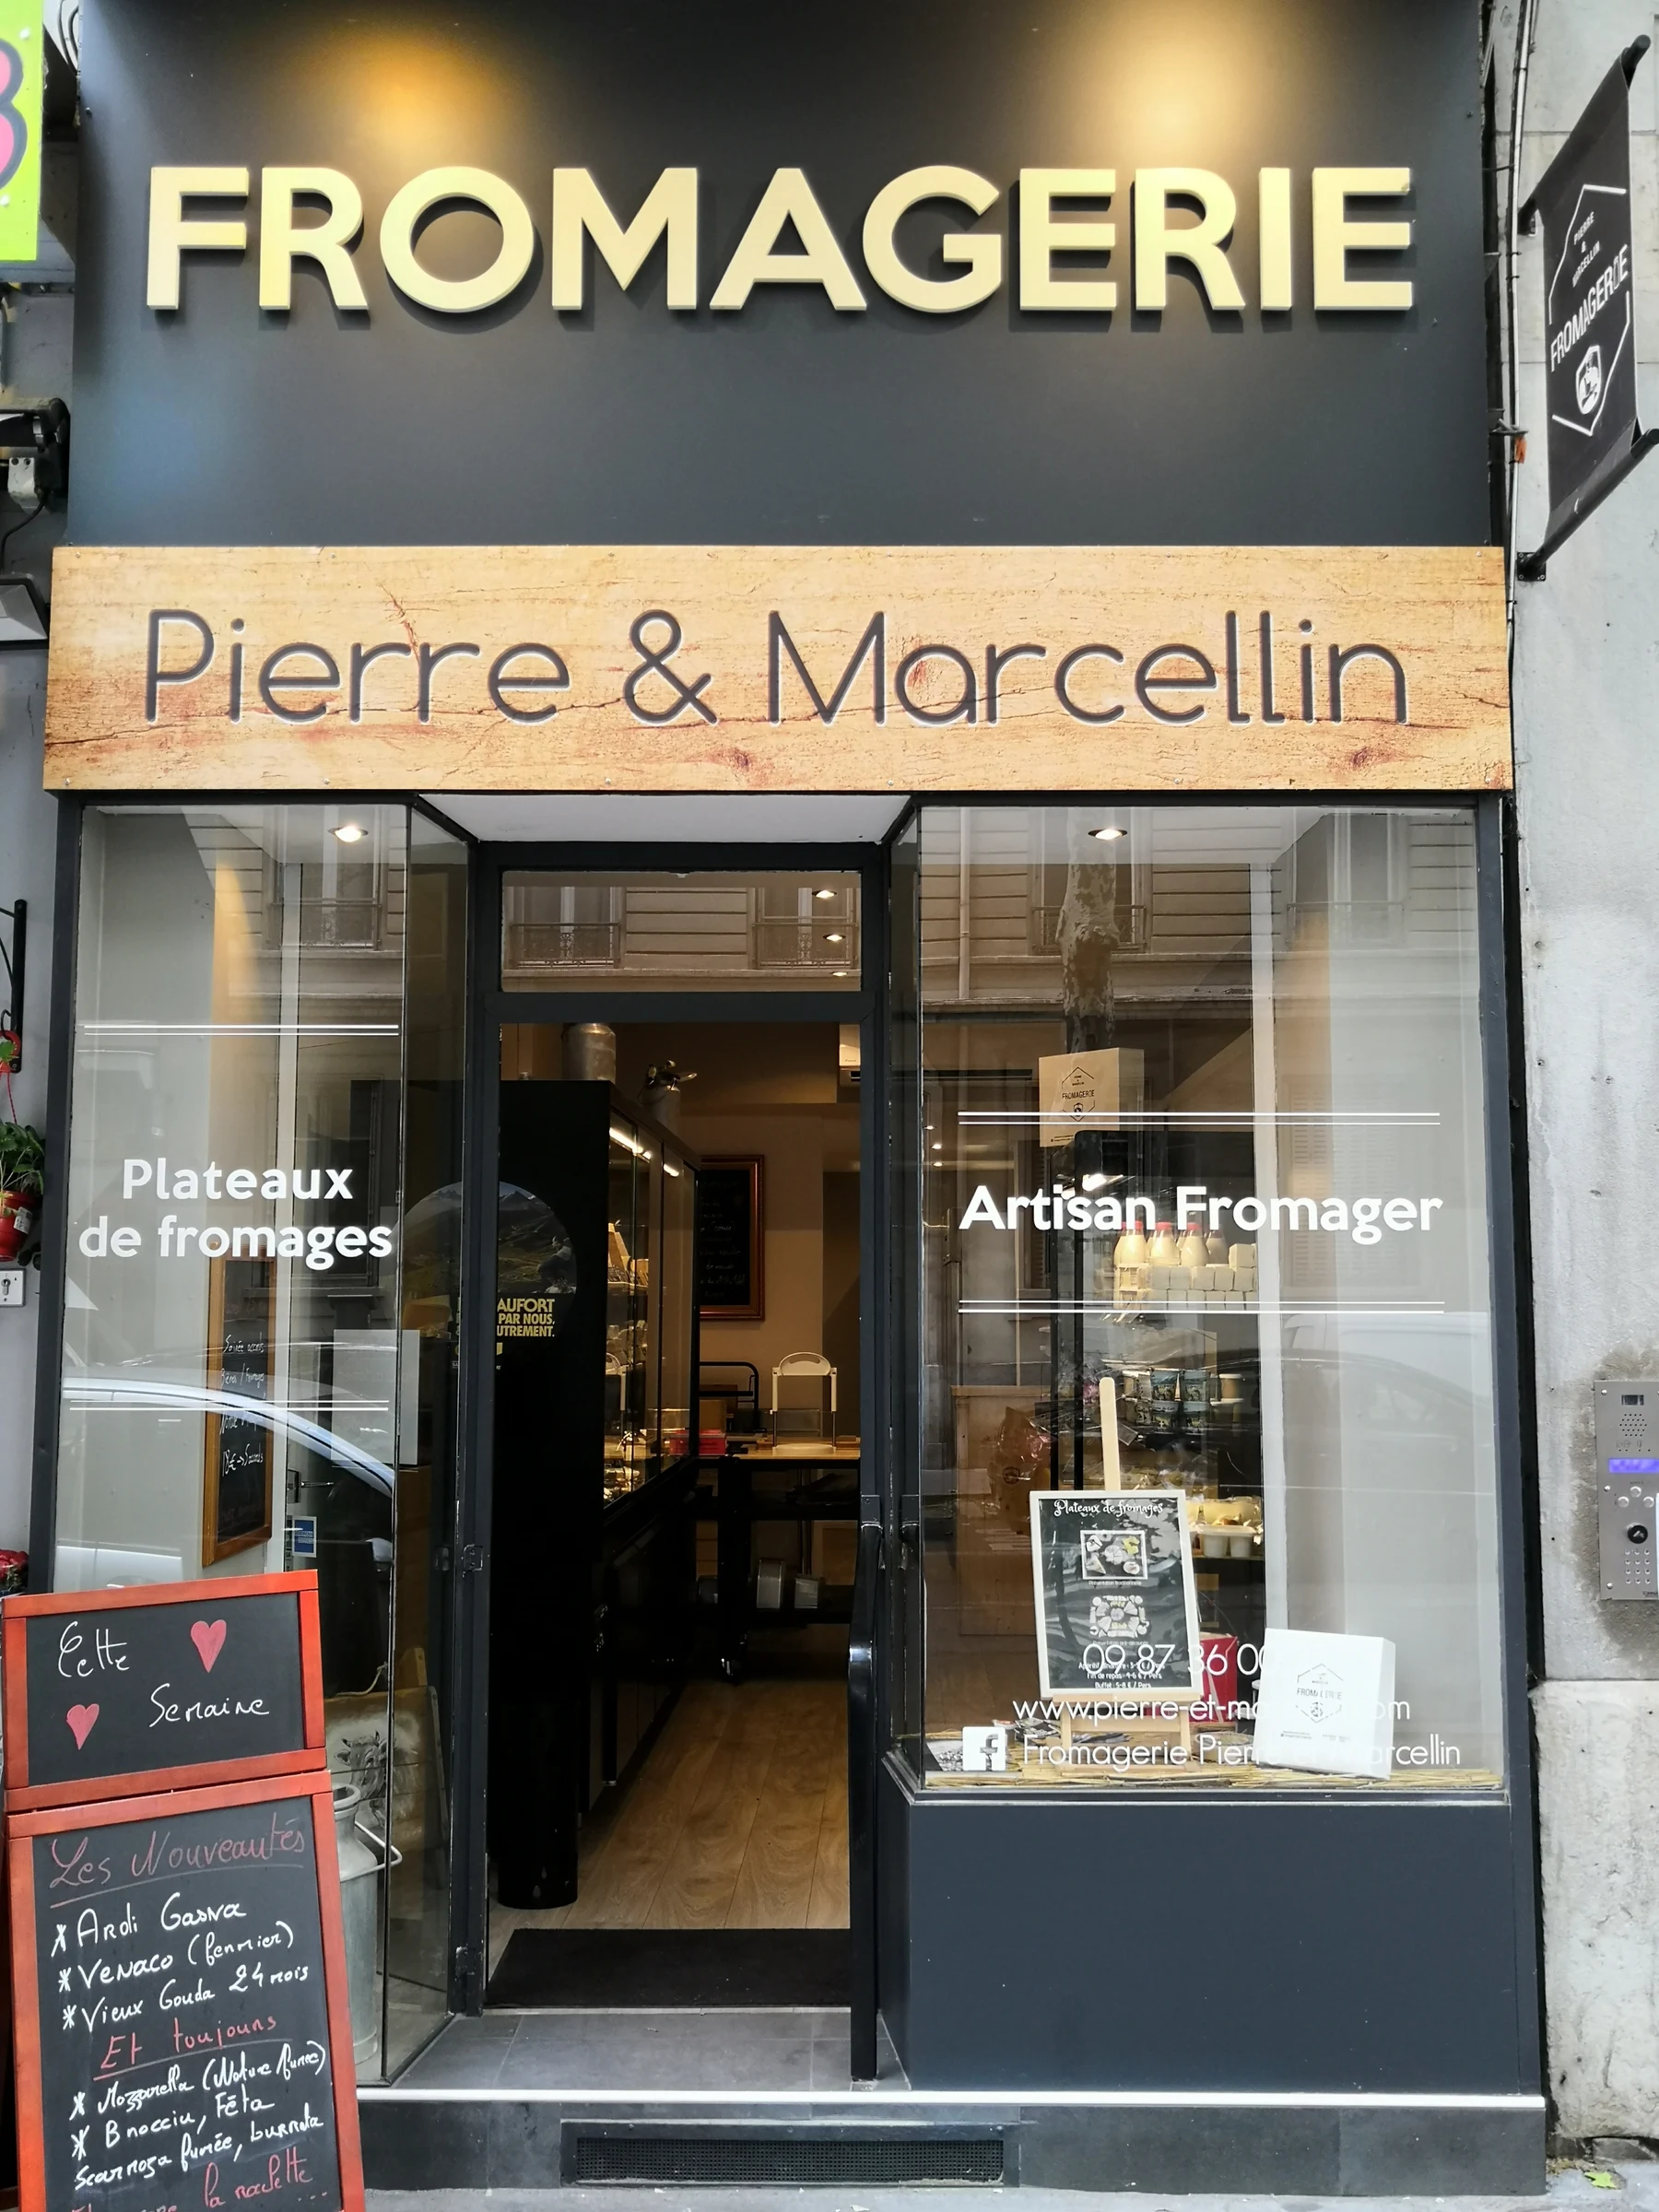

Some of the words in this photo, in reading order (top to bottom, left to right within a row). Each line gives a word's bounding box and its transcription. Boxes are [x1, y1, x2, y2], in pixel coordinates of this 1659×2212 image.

[147, 164, 1415, 313] FROMAGERIE
[1573, 211, 1594, 245] PIERRE
[1572, 240, 1600, 288] MARCELLIN
[1550, 243, 1629, 372] FROMAGERIE
[145, 608, 570, 724] Pierre
[623, 608, 719, 724] &
[767, 609, 1408, 726] Marcellin
[123, 1158, 353, 1199] Plateaux
[959, 1184, 1156, 1231] Artisan
[1177, 1185, 1443, 1245] Fromager
[79, 1216, 141, 1257] de
[159, 1215, 393, 1270] fromages
[499, 1313, 521, 1324] PAR
[523, 1313, 555, 1325] NOUS,
[1053, 1499, 1100, 1517] Plateaux
[1102, 1500, 1115, 1514] de
[1116, 1500, 1164, 1518] fromages
[58, 1621, 130, 1677] Cette
[1083, 1643, 1126, 1676] 09
[1137, 1643, 1176, 1676] 87
[1188, 1643, 1229, 1677] 36
[149, 1683, 270, 1728] Semaine
[1023, 1734, 1188, 1772] Fromagerie
[50, 1837, 111, 1888] Les
[131, 1812, 305, 1877] Nouveautés
[82, 1996, 143, 2032] Vieux
[159, 1978, 215, 2010] Gouda
[229, 1961, 264, 1993] 24
[270, 1965, 309, 1983] mois
[100, 2033, 143, 2069] Et
[173, 2016, 276, 2053] toujours
